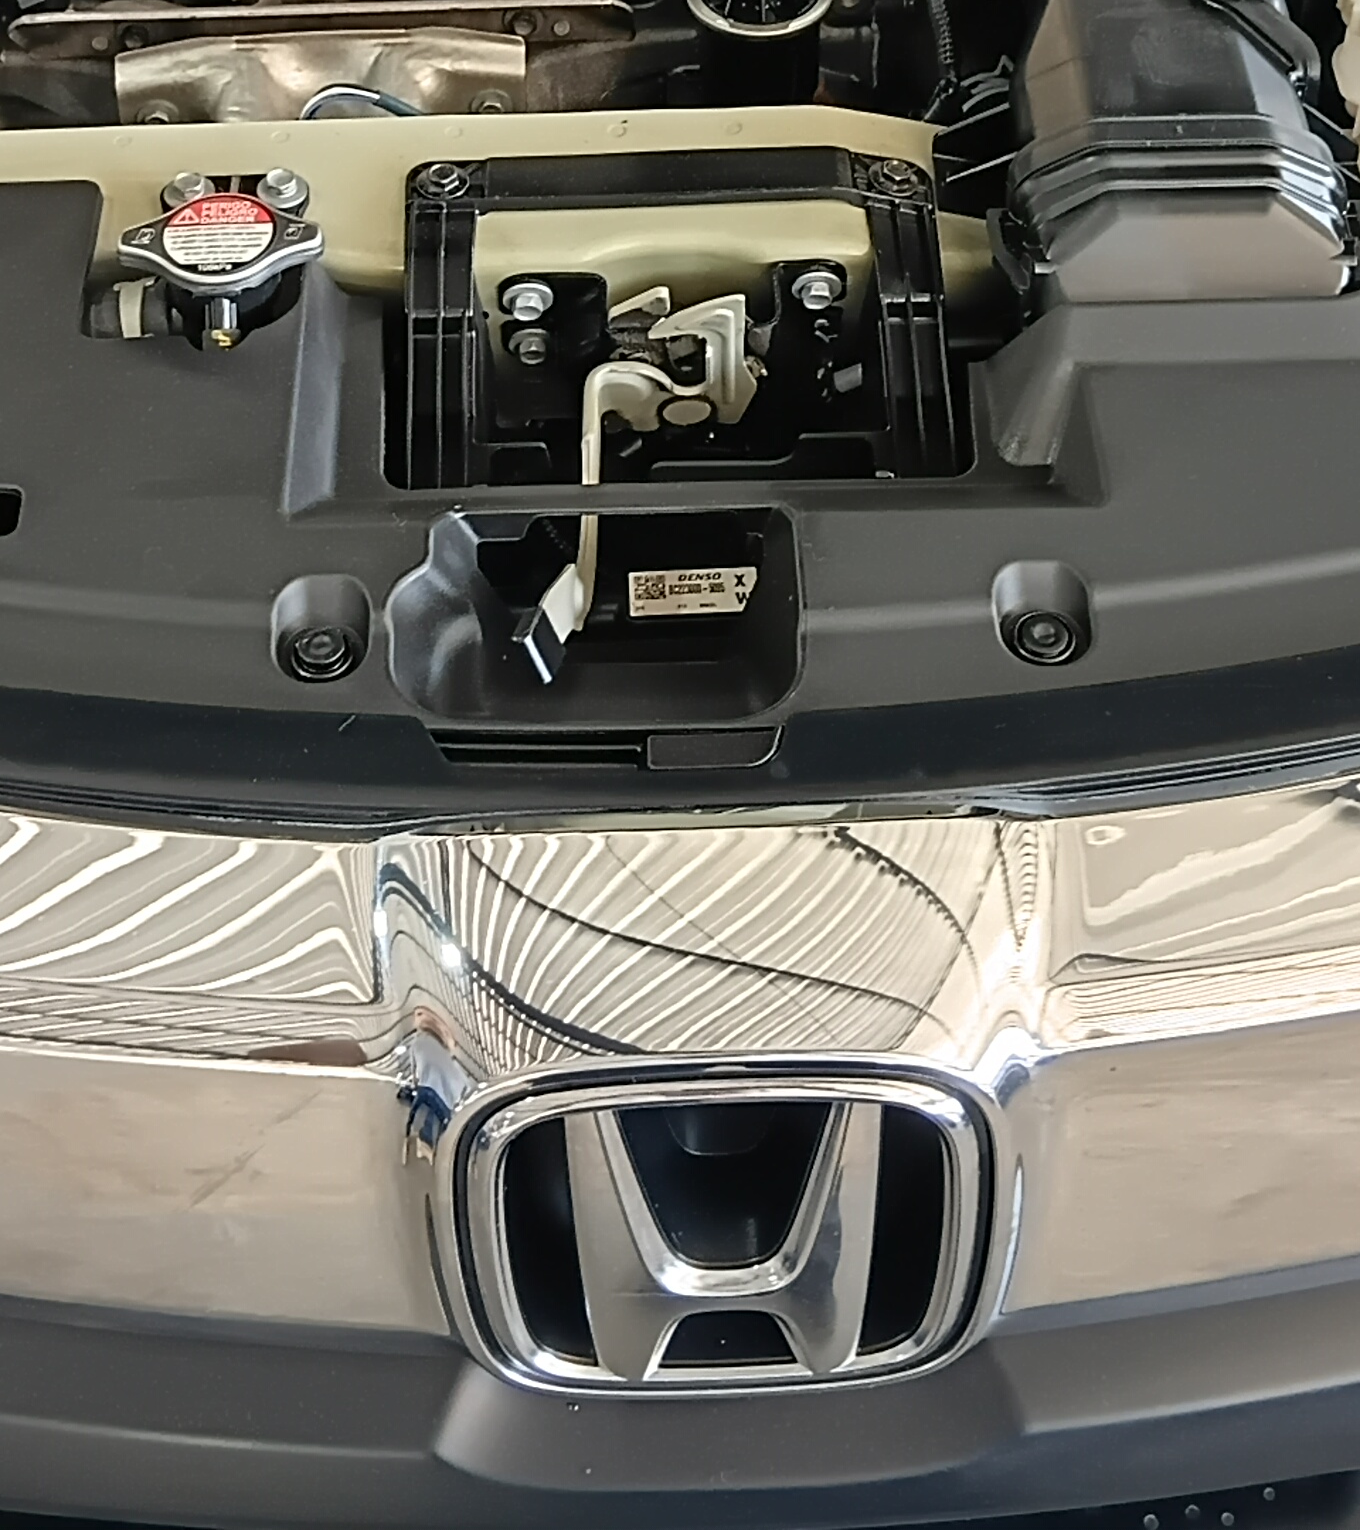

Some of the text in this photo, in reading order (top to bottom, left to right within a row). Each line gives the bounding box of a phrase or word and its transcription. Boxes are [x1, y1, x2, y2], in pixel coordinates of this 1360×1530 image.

[202, 201, 252, 210] PERIGO
[200, 216, 255, 224] DANGER
[678, 572, 721, 581] DENSO
[734, 574, 746, 587] X
